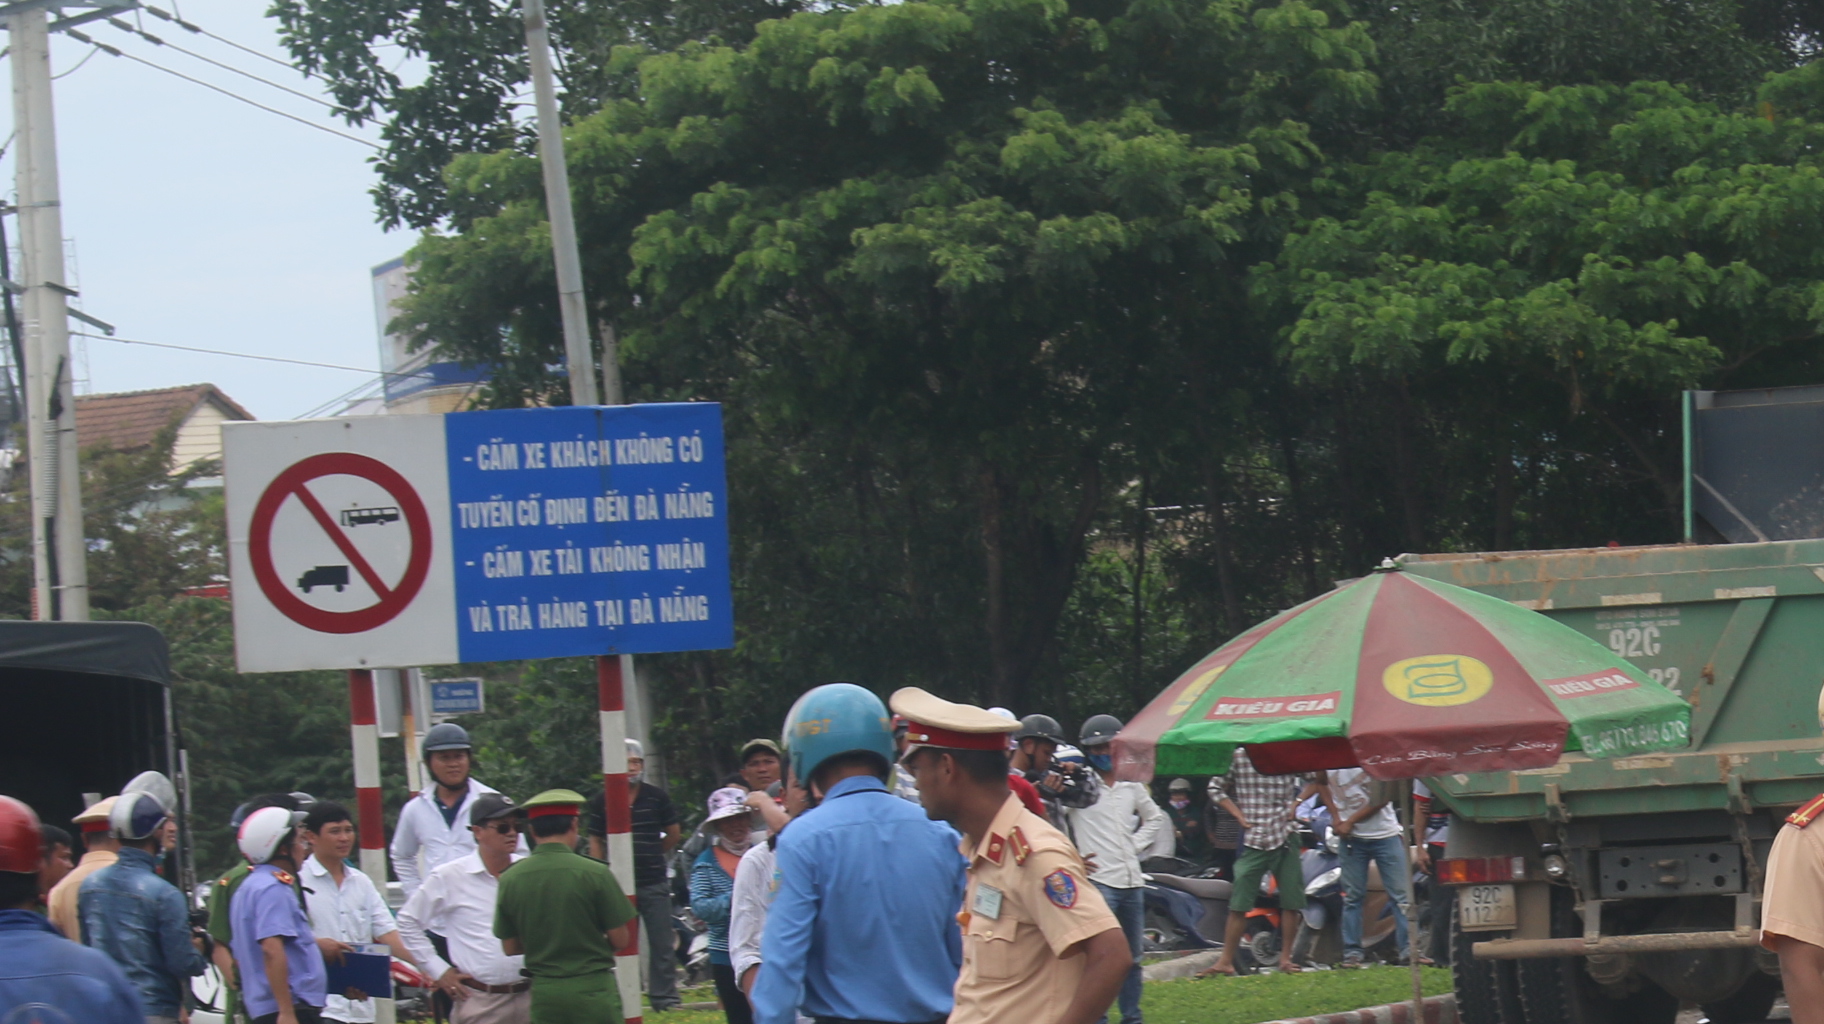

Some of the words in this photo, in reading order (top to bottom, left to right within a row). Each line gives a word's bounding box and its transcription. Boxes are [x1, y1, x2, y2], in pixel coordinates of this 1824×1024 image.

[477, 437, 518, 470] CẤM
[523, 442, 546, 469] XE
[550, 433, 611, 468] KHÁCH
[615, 432, 673, 465] KHÔNG
[678, 429, 703, 463] CÓ
[458, 494, 514, 529] TUYẾN
[516, 493, 541, 526] CỐ
[545, 497, 588, 530] ĐỊNH
[593, 489, 629, 522] ĐẾN
[634, 488, 659, 520] ĐÀ
[664, 482, 714, 519] NẴNG
[483, 544, 524, 578] CẤM
[529, 550, 553, 576] XE
[555, 540, 583, 574] TẢI
[589, 540, 650, 573] KHÔNG
[656, 538, 706, 573] NHẬN
[469, 600, 494, 632] VÀ
[496, 597, 533, 631] TRẢ
[537, 597, 588, 629] HÀNG
[595, 599, 624, 630] TẠI
[630, 592, 655, 624] ĐÀ
[659, 586, 709, 623] NẴNG
[1609, 626, 1661, 658] 92C
[1592, 674, 1634, 689] GIA
[1286, 698, 1335, 712] GIA
[1472, 886, 1502, 904] 92C
